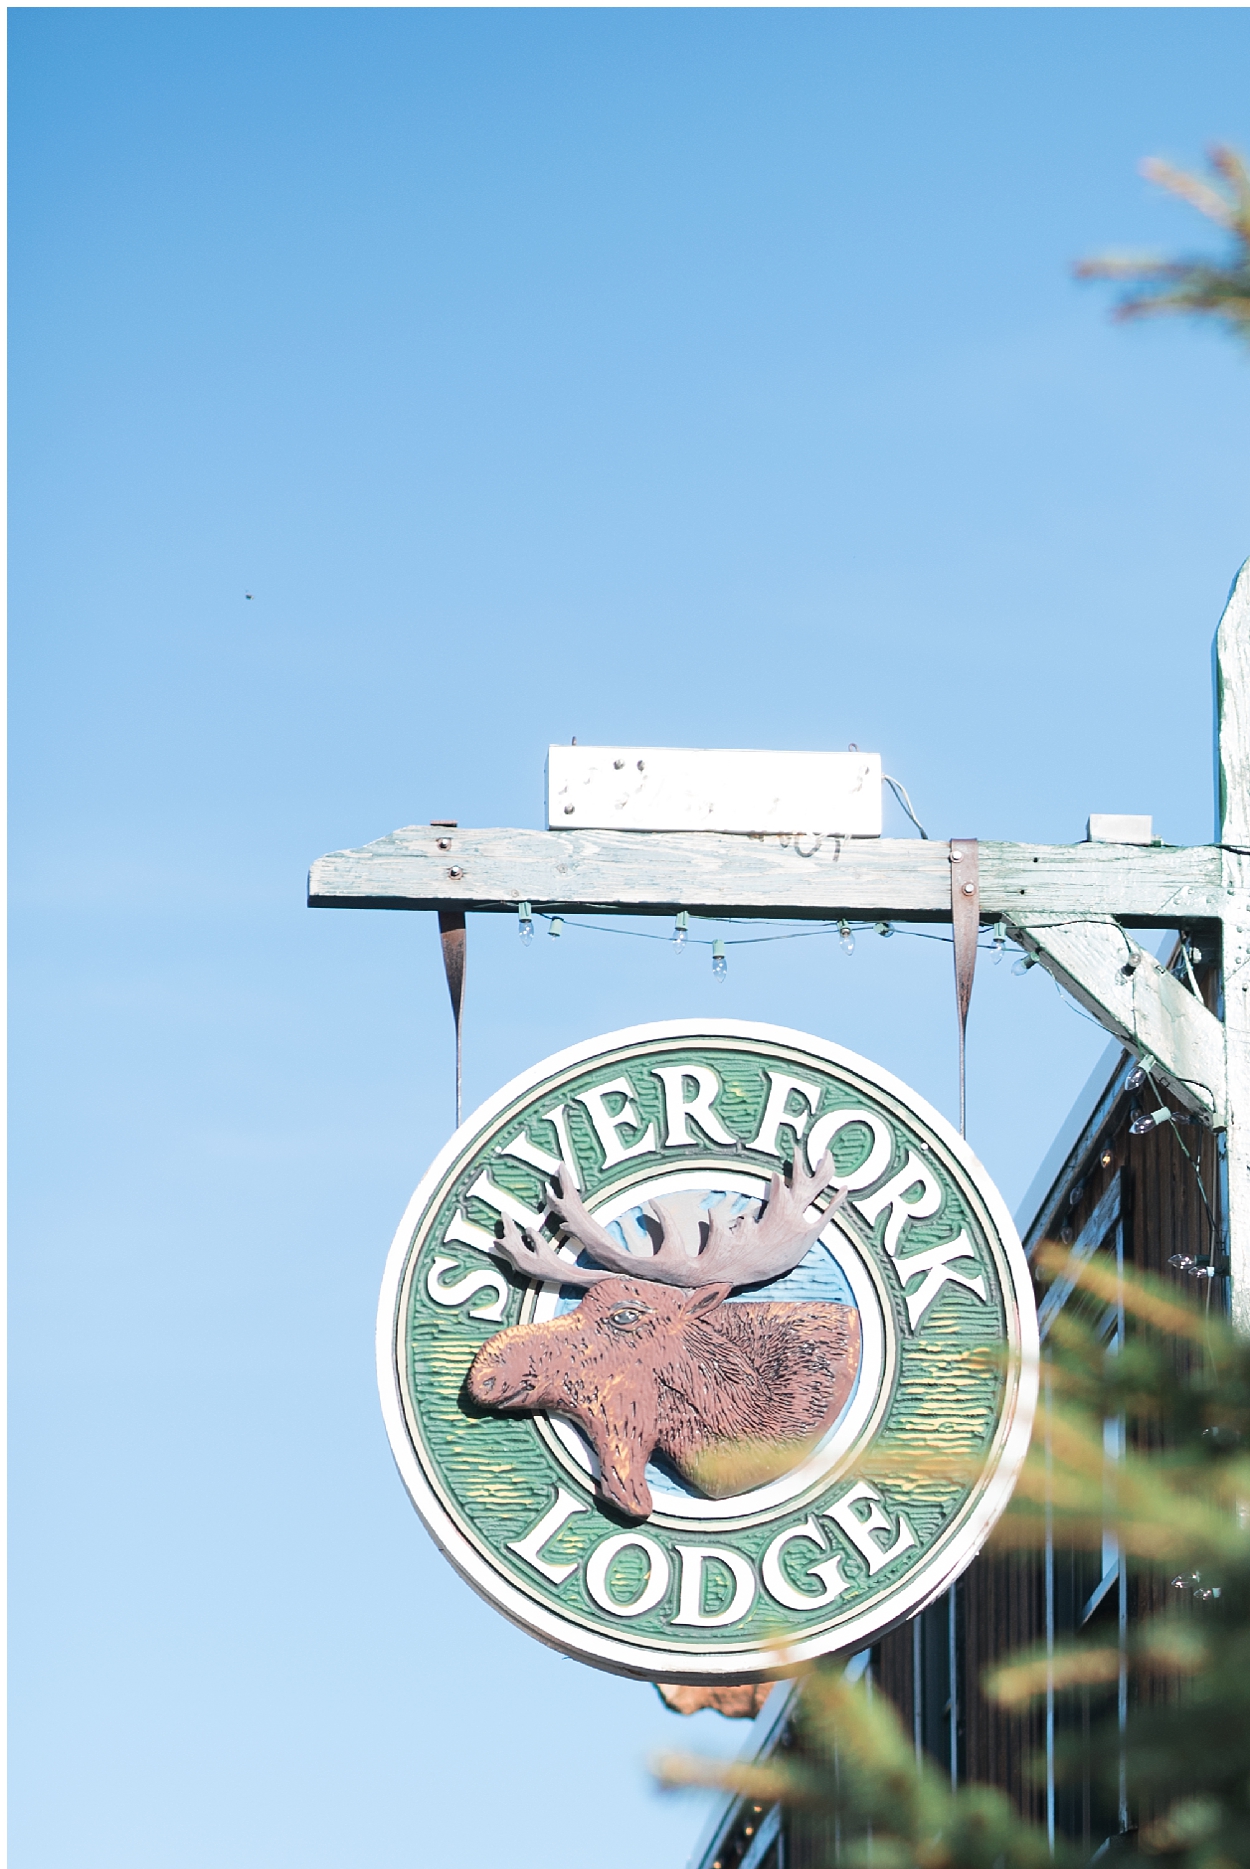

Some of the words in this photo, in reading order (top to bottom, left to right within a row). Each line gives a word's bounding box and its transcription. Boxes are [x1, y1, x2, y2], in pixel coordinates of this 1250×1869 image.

[427, 1064, 742, 1322] SILVER
[746, 1071, 987, 1331] FORK
[506, 1480, 917, 1627] LODGE
